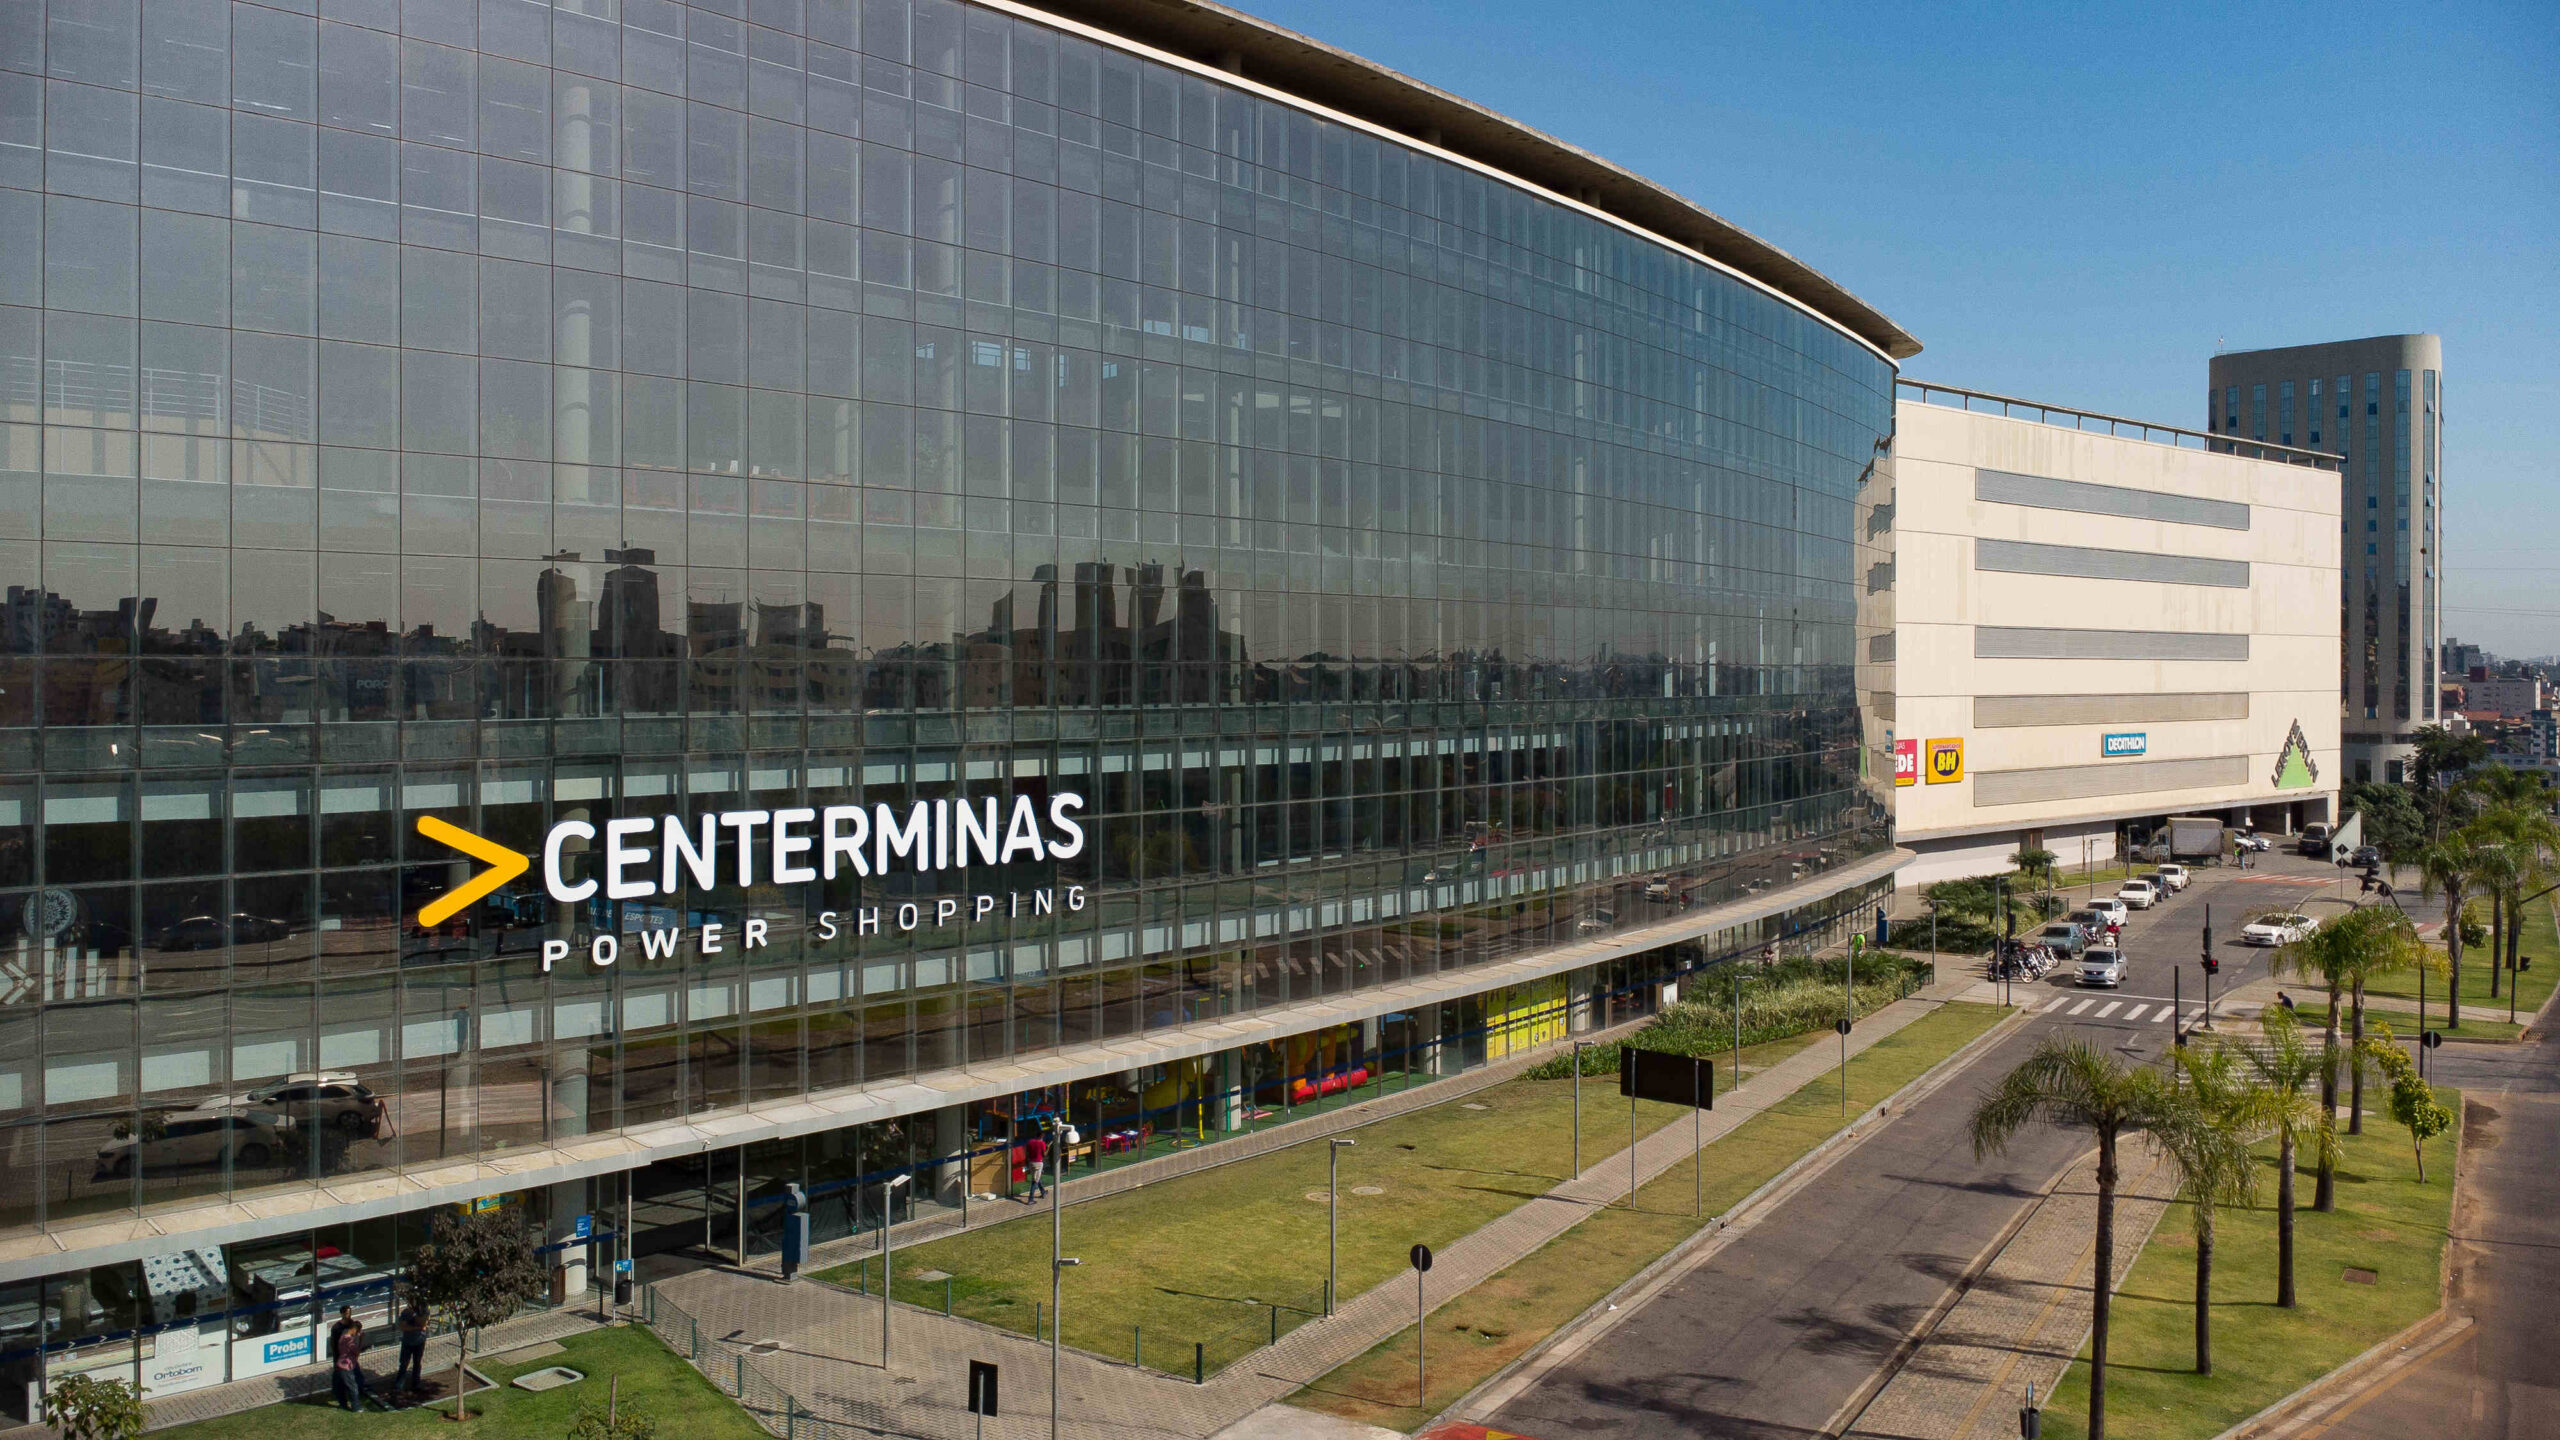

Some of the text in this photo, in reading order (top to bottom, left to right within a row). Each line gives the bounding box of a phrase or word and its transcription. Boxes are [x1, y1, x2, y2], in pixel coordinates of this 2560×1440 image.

[2108, 736, 2145, 750] DECATHLON
[2271, 717, 2319, 787] LEROY MERLIN
[1937, 752, 1956, 771] BH
[544, 792, 1084, 903] CENTERMINAS
[624, 912, 665, 925] ESPOTES
[543, 885, 1085, 972] POWER SHOPPING
[269, 1337, 308, 1356] Probel
[153, 1365, 203, 1381] Ortobom
